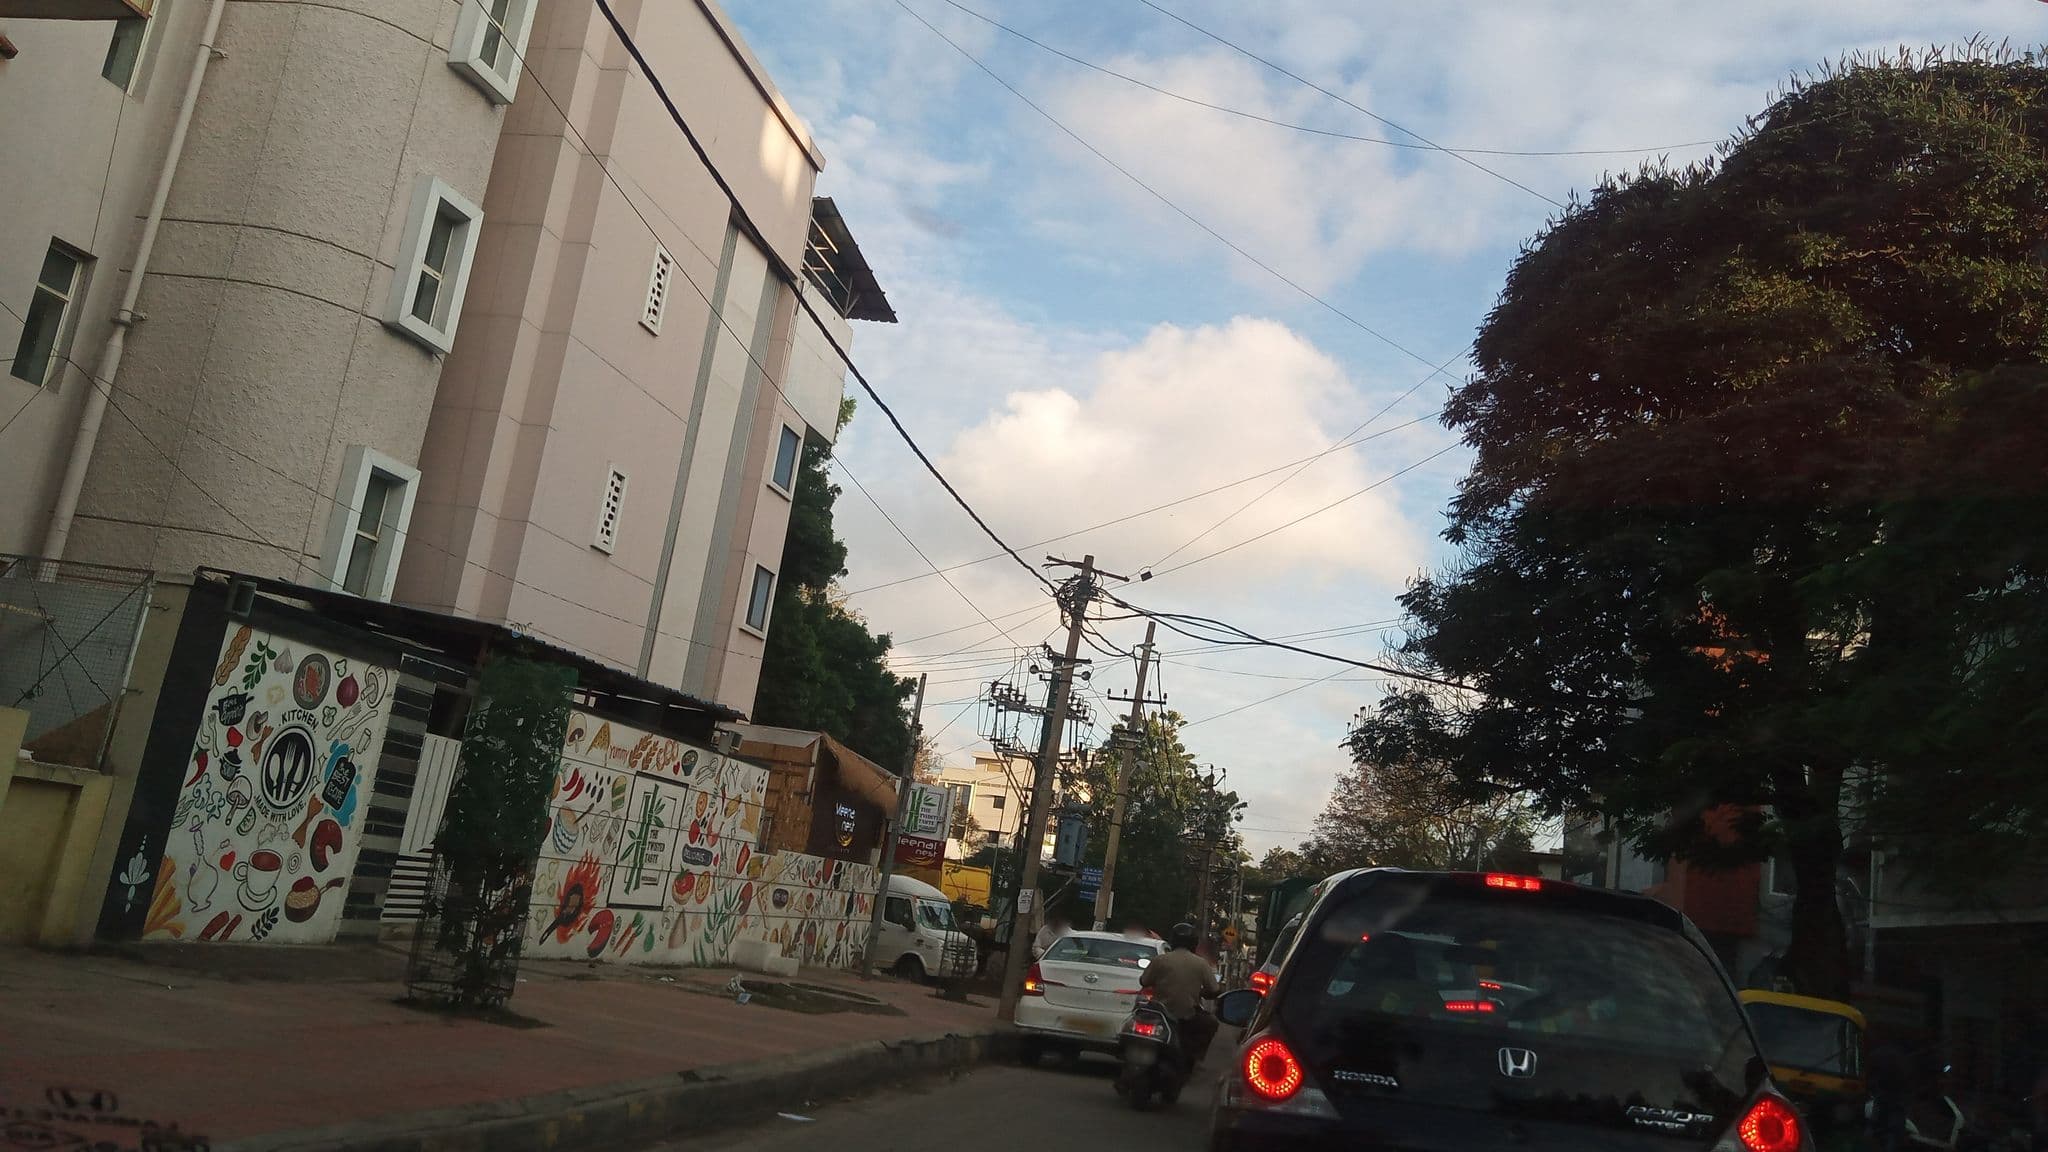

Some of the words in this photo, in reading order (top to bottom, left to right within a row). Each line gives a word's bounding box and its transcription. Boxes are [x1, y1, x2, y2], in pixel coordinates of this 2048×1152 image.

[281, 709, 319, 731] KITCHEN
[255, 795, 270, 818] MADE
[270, 813, 287, 822] WITH
[287, 801, 305, 820] LOVE
[1333, 1070, 1399, 1088] HONDA
